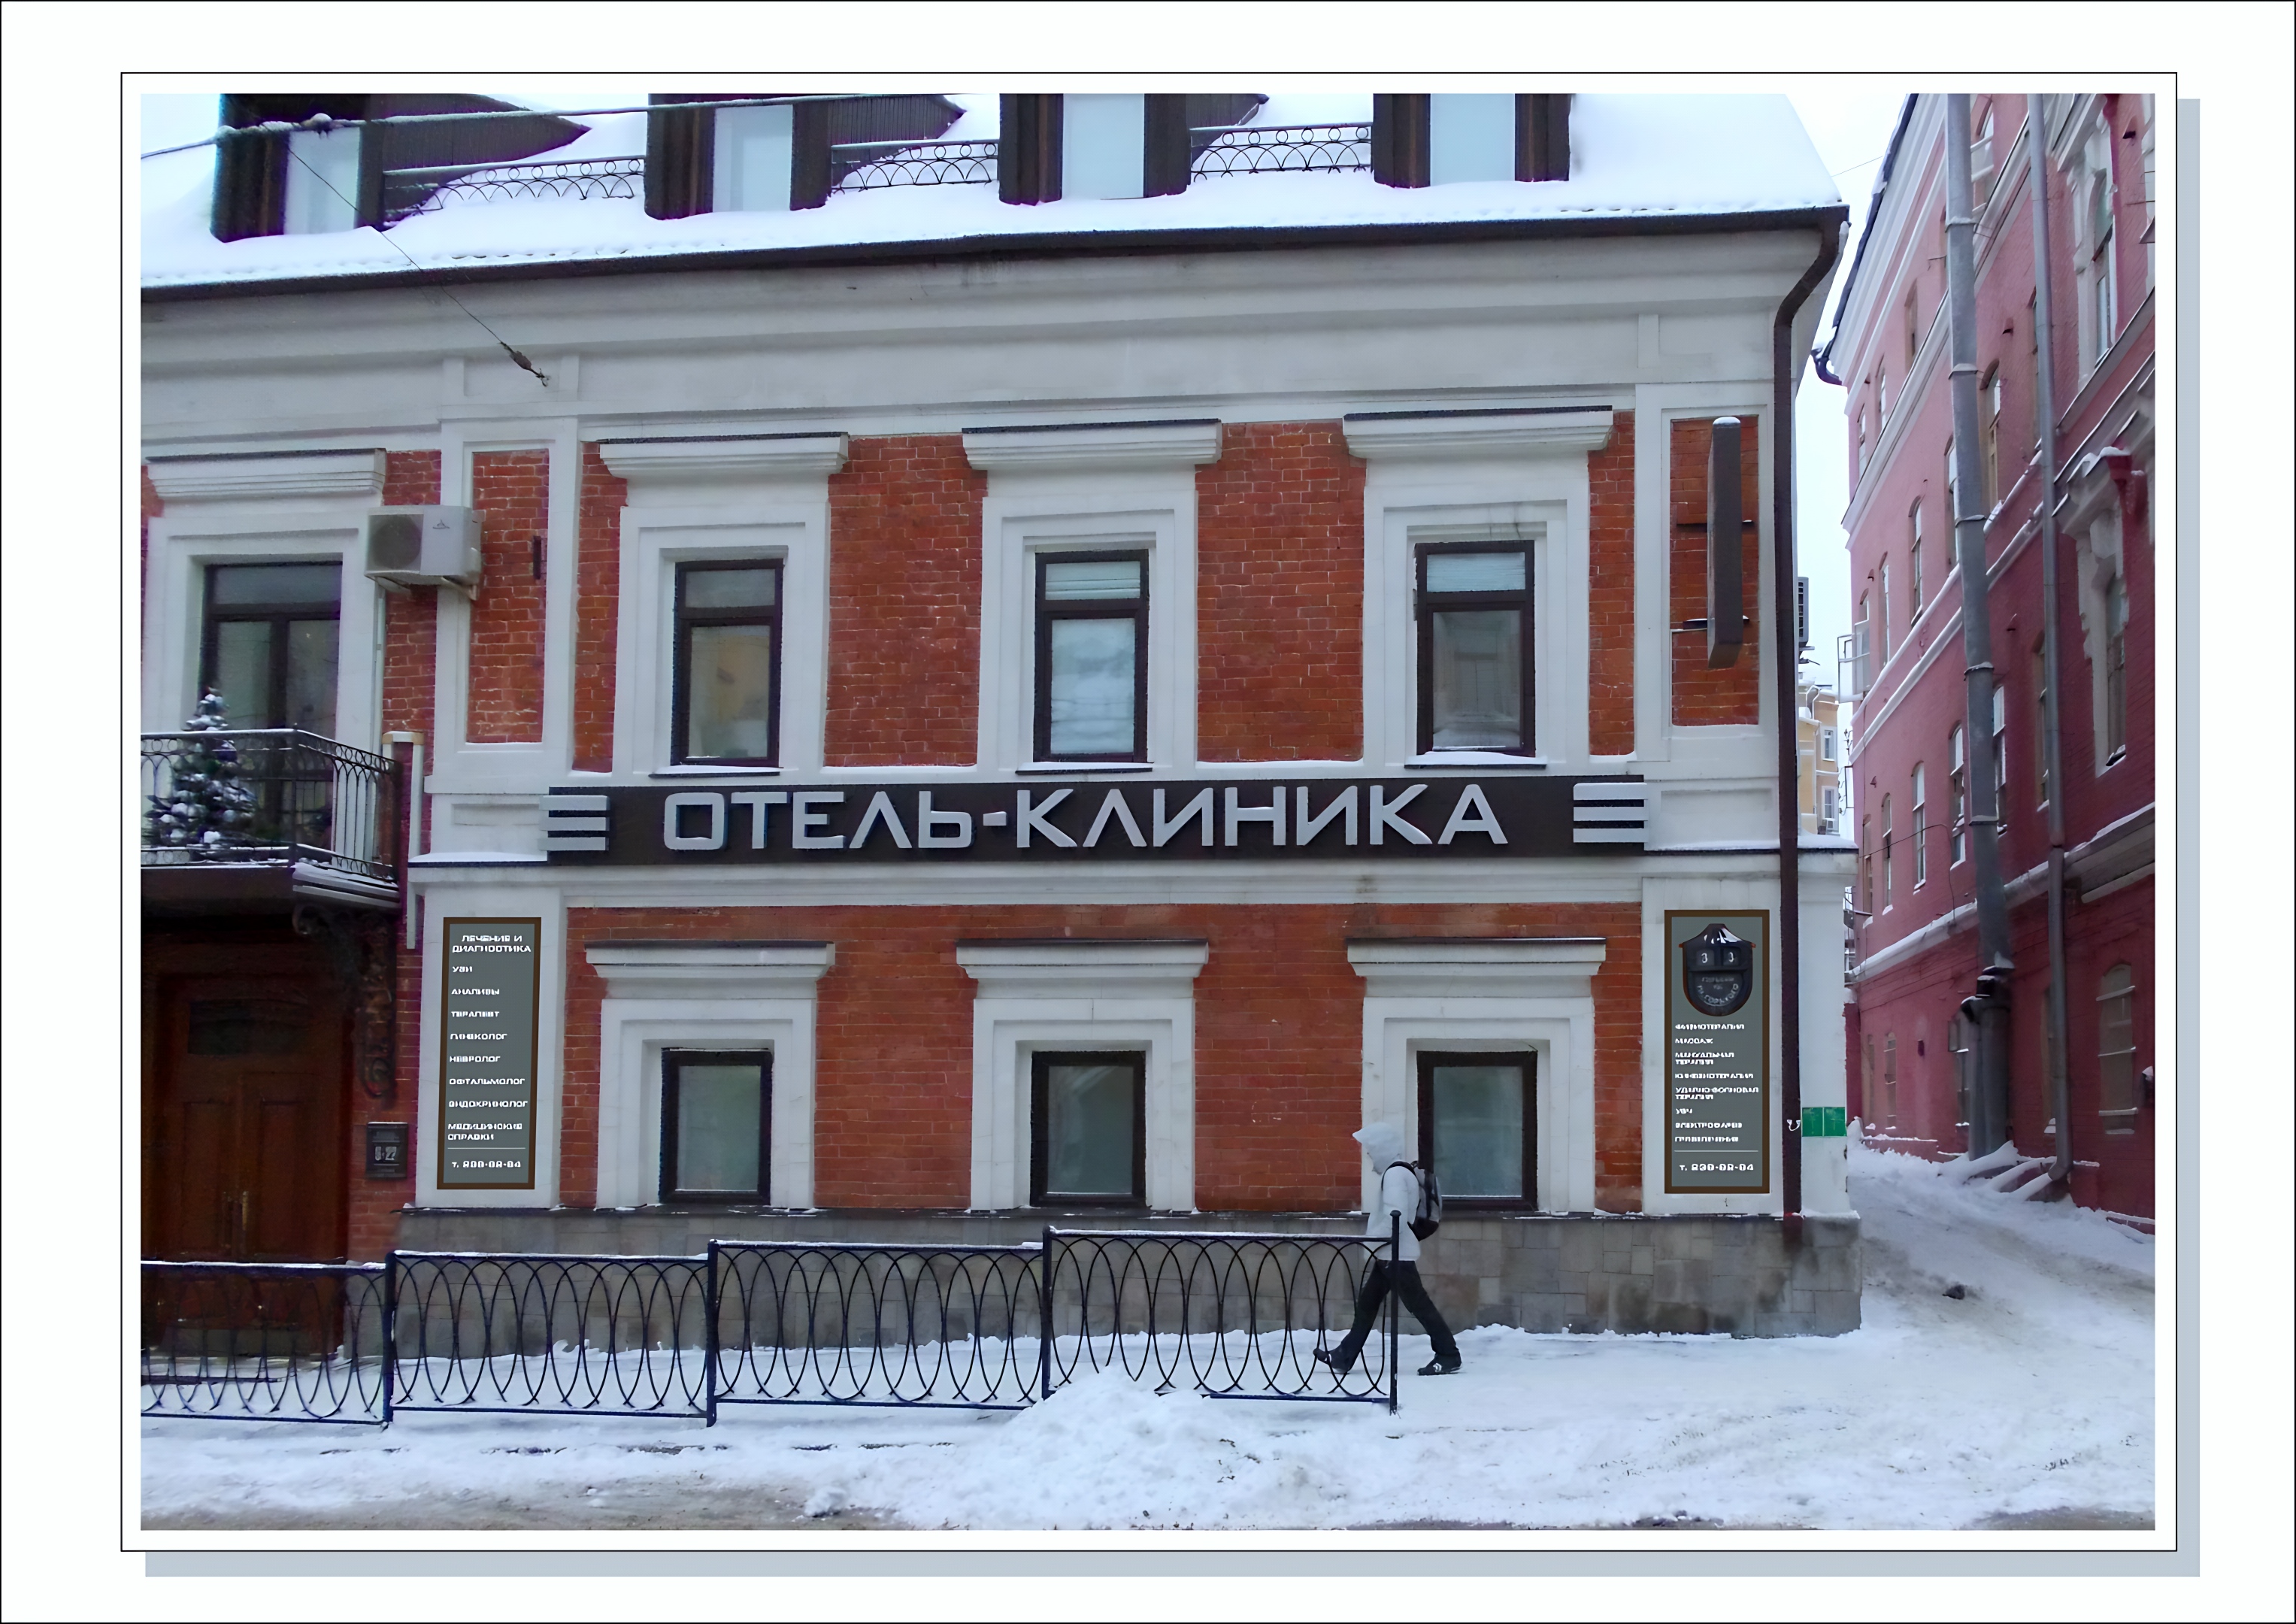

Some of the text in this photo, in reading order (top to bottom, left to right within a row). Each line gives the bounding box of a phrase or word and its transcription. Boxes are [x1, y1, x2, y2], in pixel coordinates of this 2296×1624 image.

[664, 784, 1508, 850] ОТЕЛЬ-КЛИНИКА
[452, 945, 532, 953] ДИАГНОСТИКА
[448, 1100, 529, 1108] ЭНДОКРИНОЛОГ
